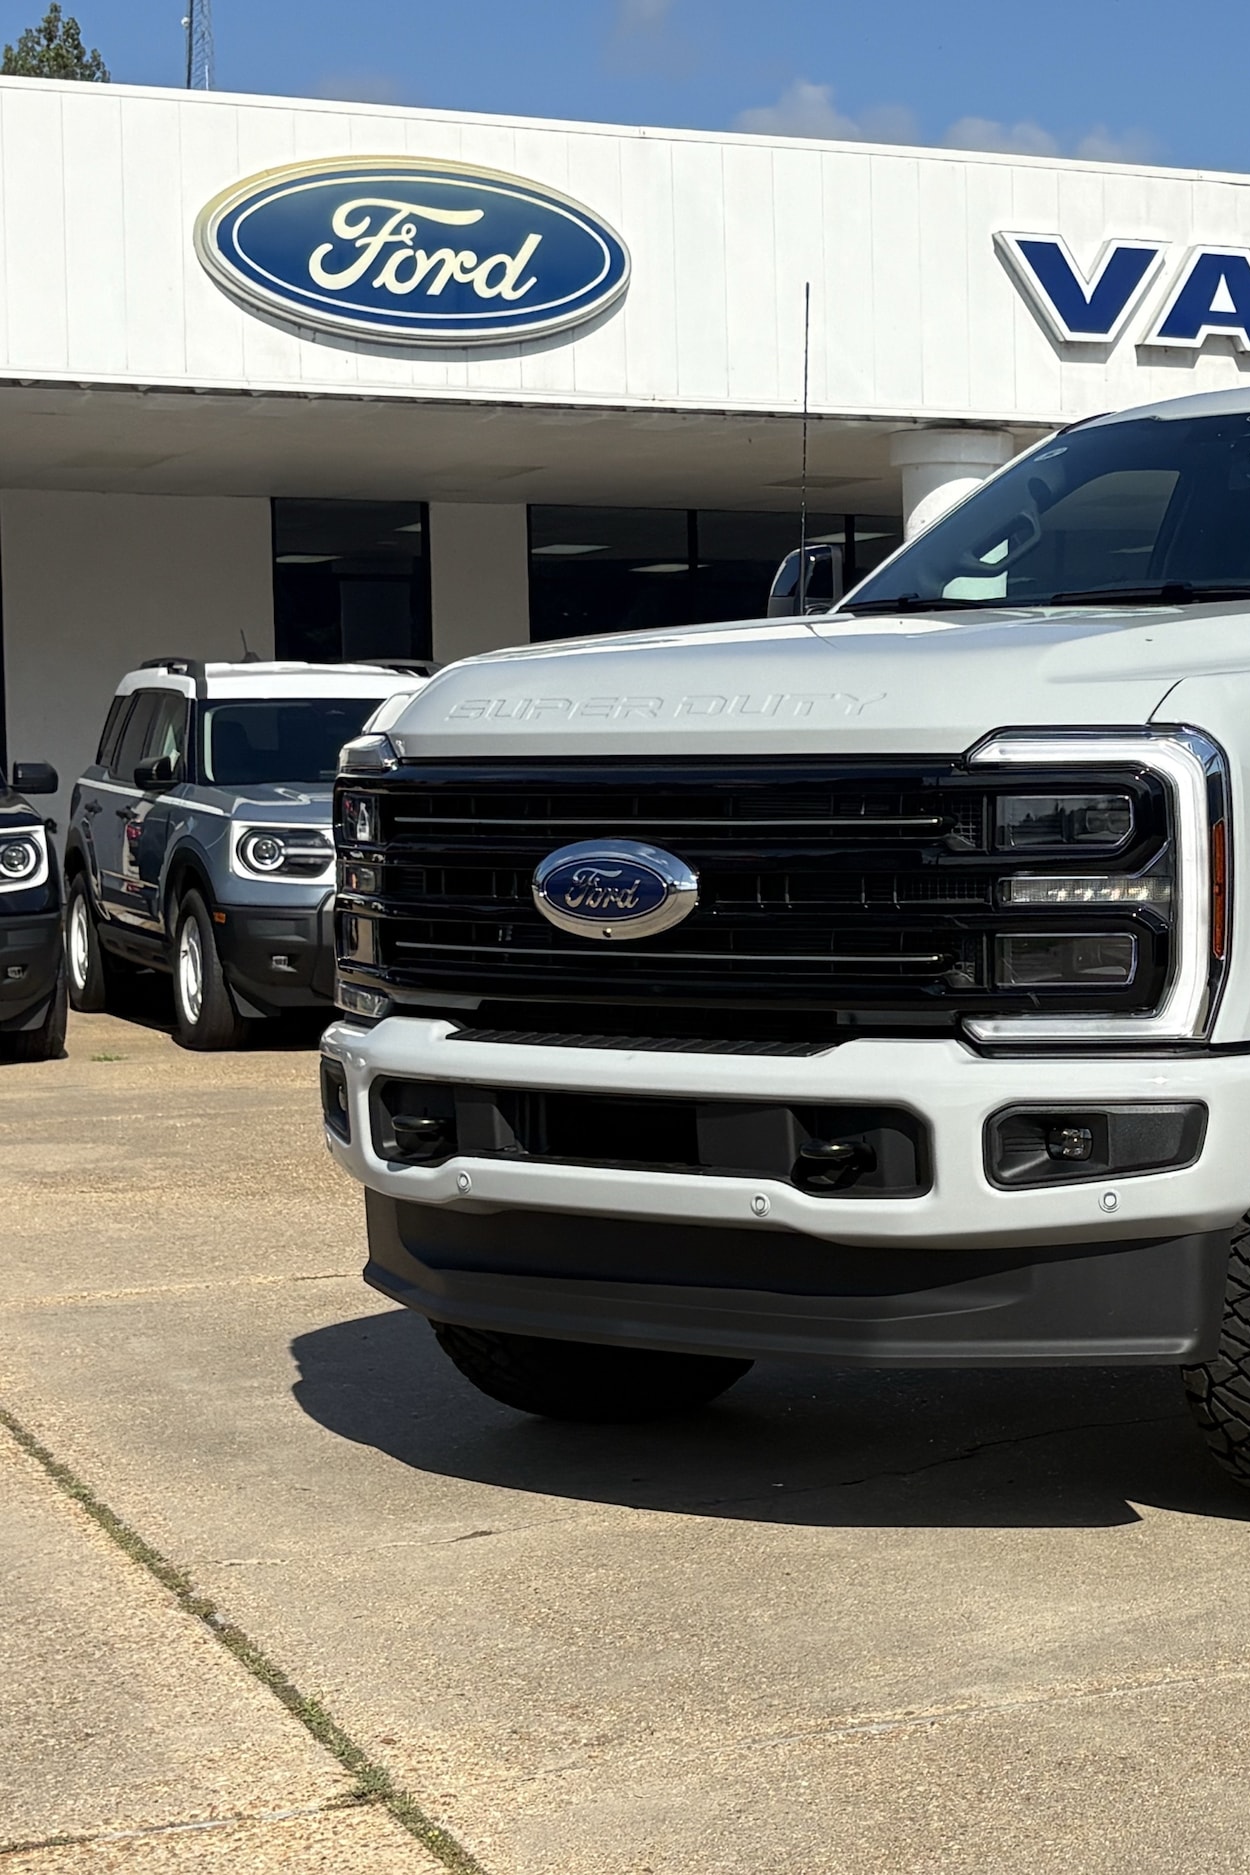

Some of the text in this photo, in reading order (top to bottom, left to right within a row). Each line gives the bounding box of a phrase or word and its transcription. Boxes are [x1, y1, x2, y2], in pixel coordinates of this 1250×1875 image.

[308, 198, 542, 301] Ford
[445, 692, 888, 721] SUPER DUTY
[564, 867, 641, 909] Ford
